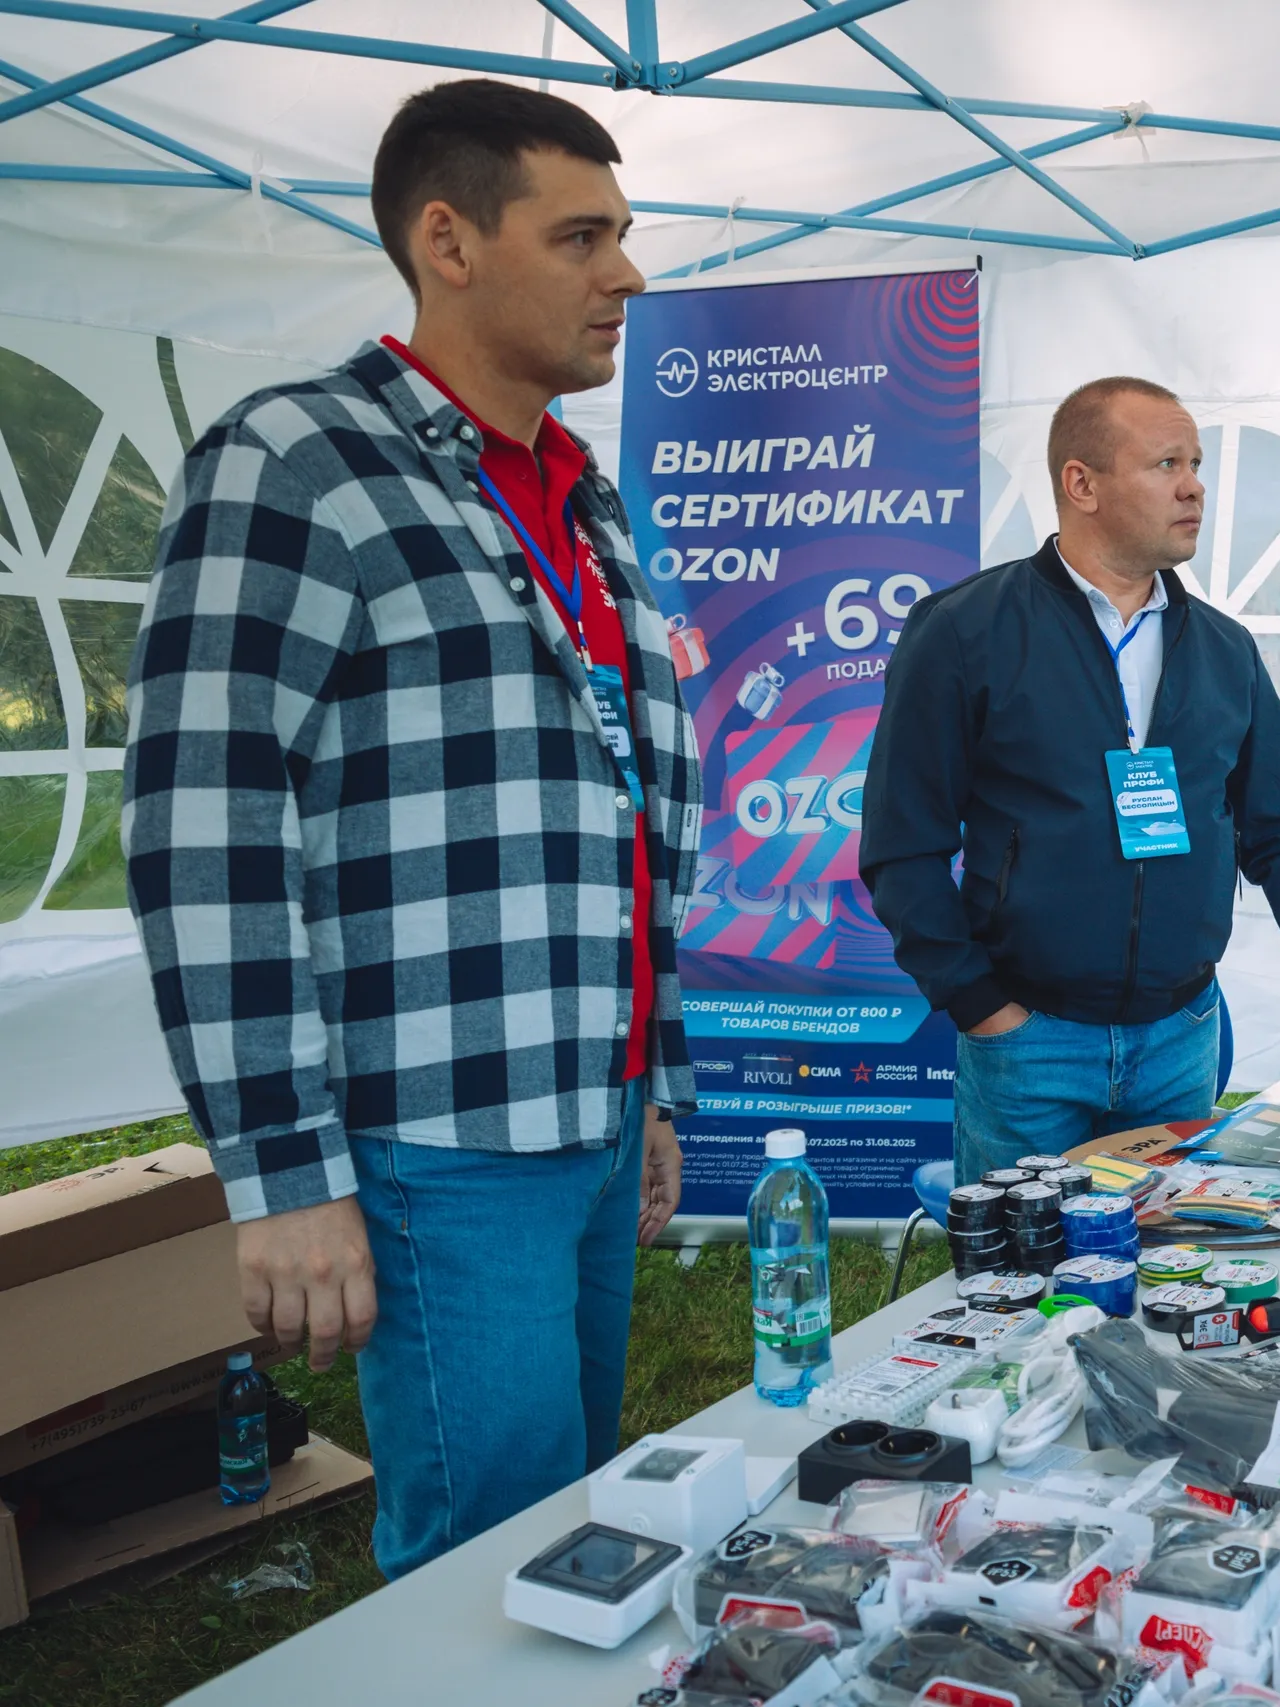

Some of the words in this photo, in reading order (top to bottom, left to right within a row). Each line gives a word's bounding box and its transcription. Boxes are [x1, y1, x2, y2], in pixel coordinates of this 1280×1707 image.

[707, 344, 822, 368] КРИСТАЛЛ
[707, 365, 888, 393] ЭЛЕКТРОЦЕНТР
[651, 424, 875, 475] ВЫИГРАЙ
[650, 489, 964, 528] СЕРТИФИКАТ
[650, 547, 781, 582] OZON
[827, 659, 886, 680] ПОДА
[1123, 779, 1164, 788] ПРОФИ
[1128, 771, 1157, 780] КЛУБ
[737, 770, 866, 838] OZO
[1135, 842, 1178, 852] УЧАСТНИК
[682, 1000, 764, 1013] СОВЕРШАЙ
[769, 1003, 833, 1017] ПОКУПКИ
[836, 1006, 858, 1017] ОТ
[861, 1006, 887, 1018] 800
[721, 1018, 789, 1031] ТОВАРОВ
[792, 1020, 860, 1034] БРЕНДОВ
[811, 1067, 841, 1077] СИЛА
[876, 1064, 917, 1073] АРМИЯ
[876, 1072, 917, 1081] РОССИИ
[926, 1067, 955, 1080] Intr
[743, 1071, 793, 1085] RIVOLI
[696, 1097, 740, 1110] СТВУЙ
[744, 1101, 753, 1110] В
[757, 1101, 842, 1114] РОЗЫГРЫШЕ
[690, 1134, 753, 1145] проведения
[806, 1138, 848, 1147] .07.2025
[850, 1139, 863, 1147] по
[865, 1138, 916, 1147] 31.08.2025
[1120, 1137, 1168, 1154] ЭРА
[1199, 1319, 1208, 1333] ЭРА
[1228, 1550, 1256, 1571] IP55
[987, 1567, 1018, 1579] IP55
